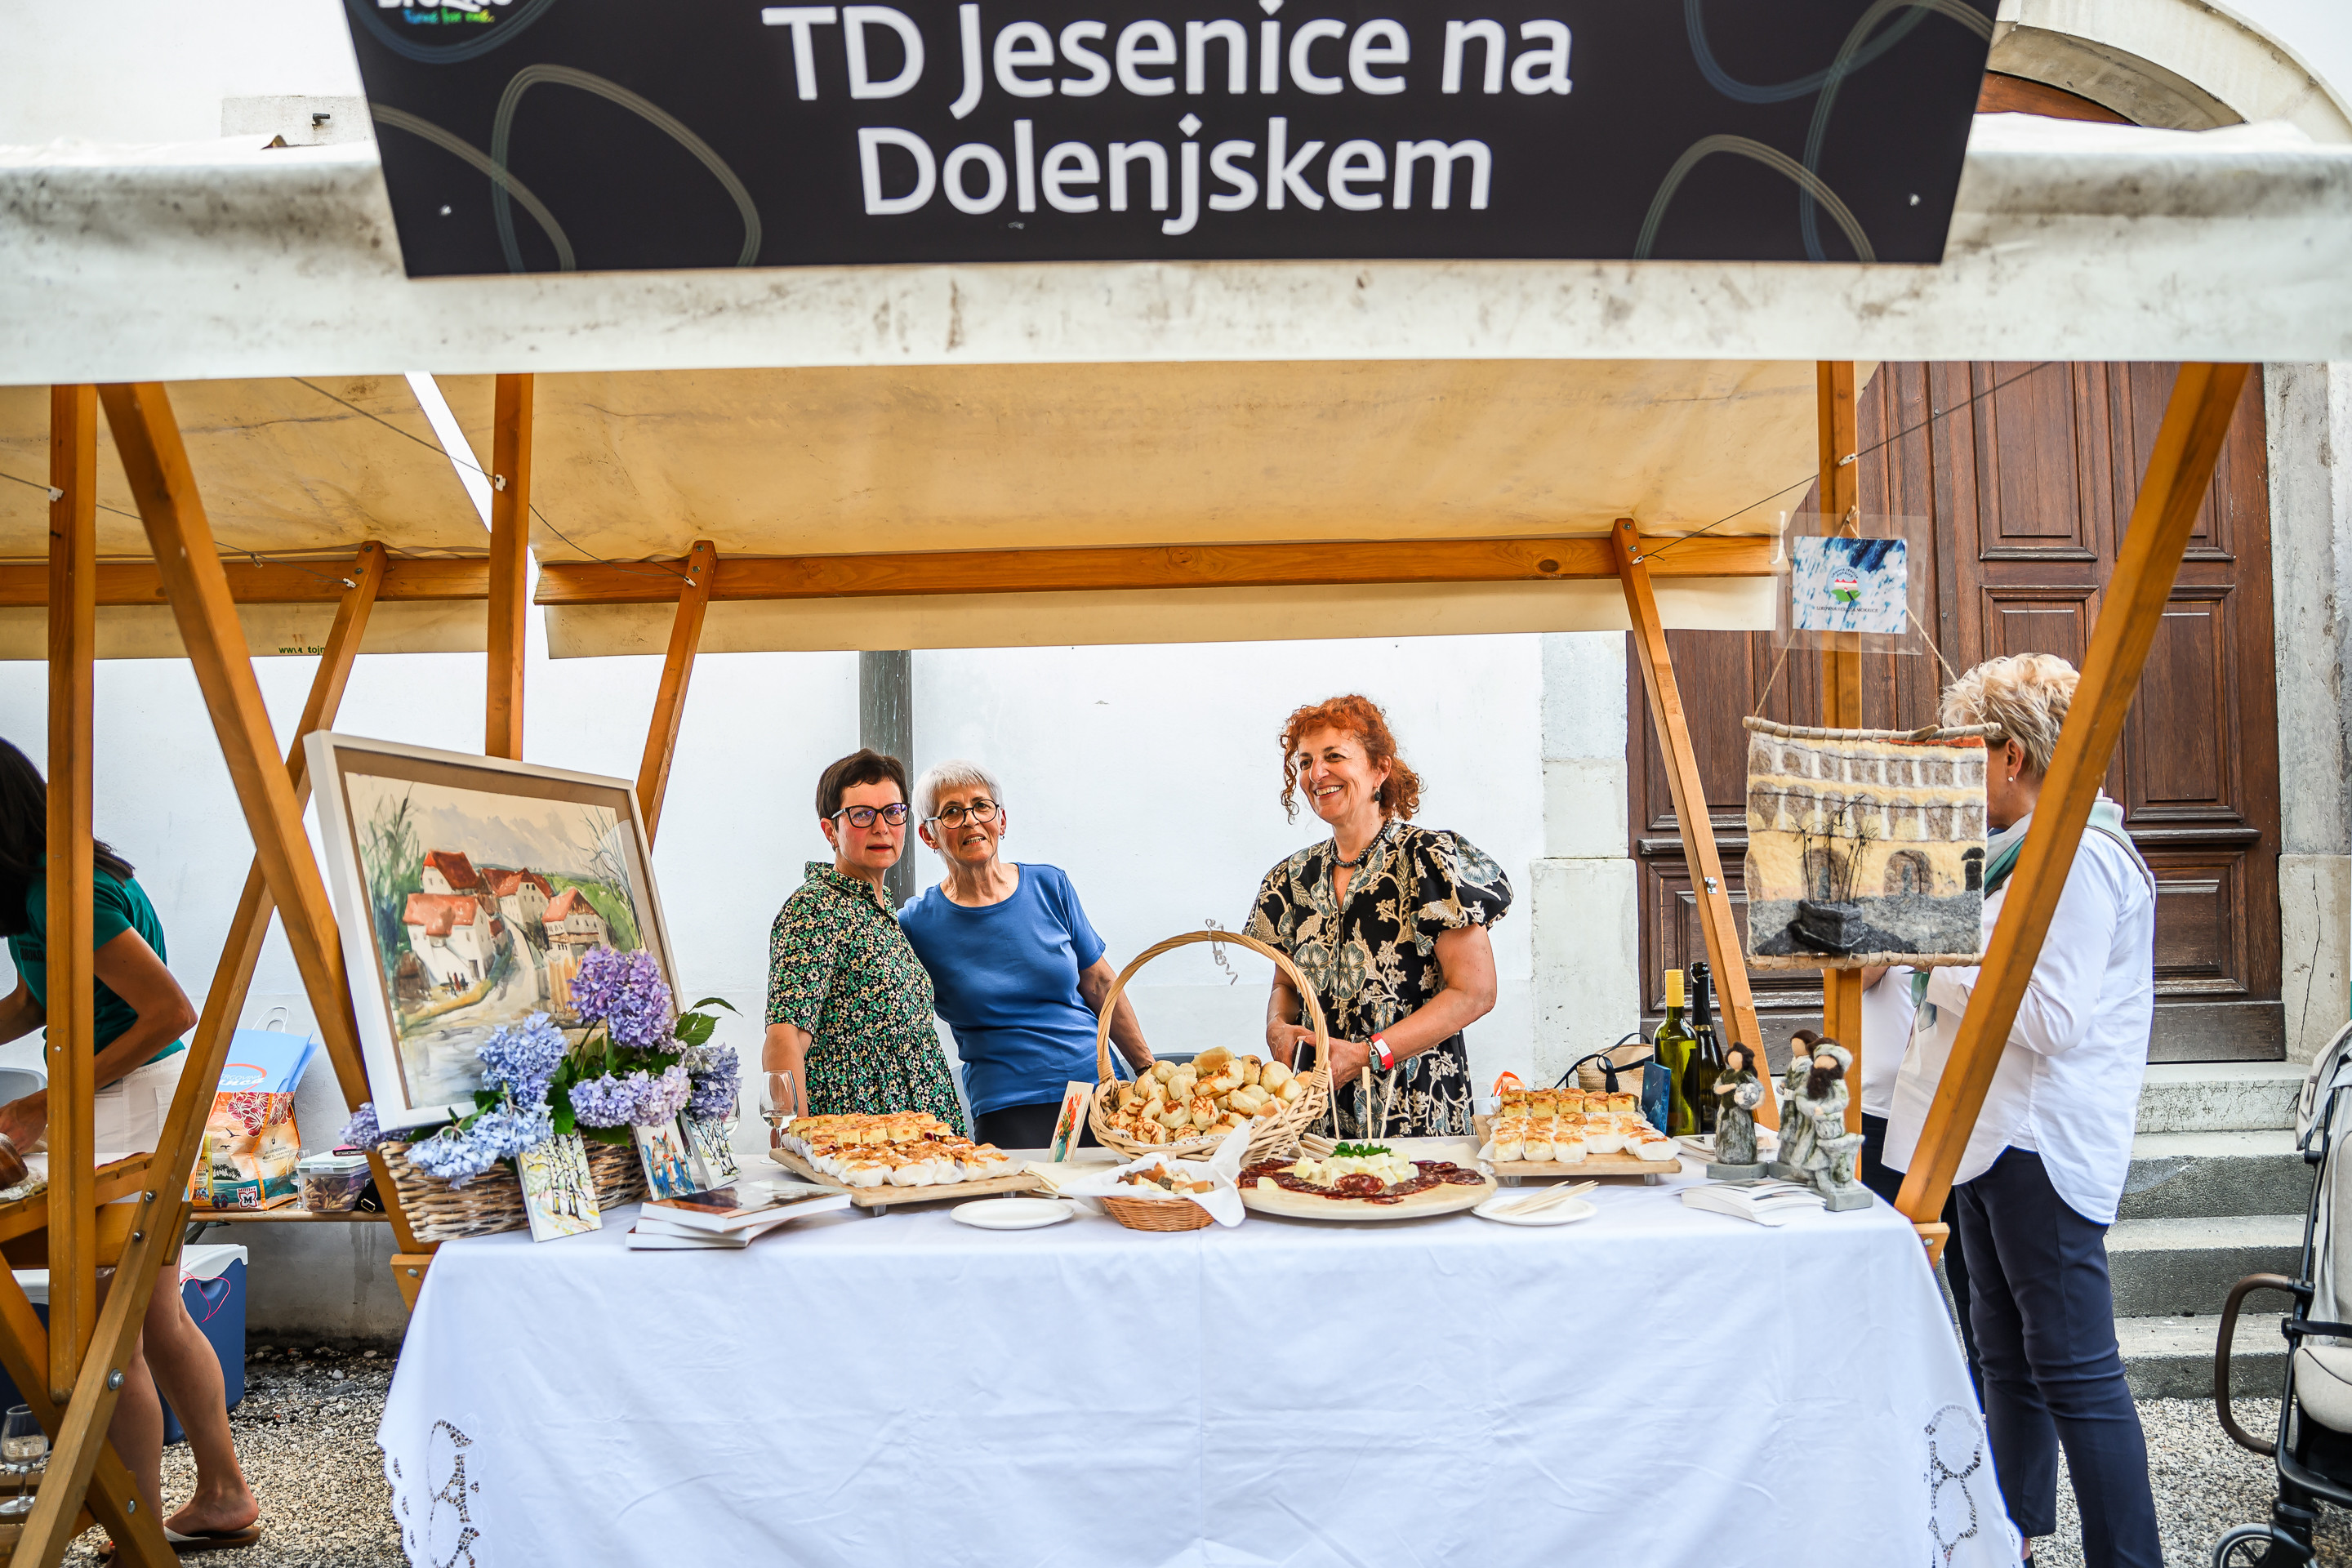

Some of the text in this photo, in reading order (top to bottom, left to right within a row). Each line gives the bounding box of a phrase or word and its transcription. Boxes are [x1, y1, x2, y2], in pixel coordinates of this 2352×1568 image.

[761, 0, 1572, 119] TD Jesenice na
[858, 114, 1491, 235] Dolenjskem
[243, 1196, 252, 1204] M
